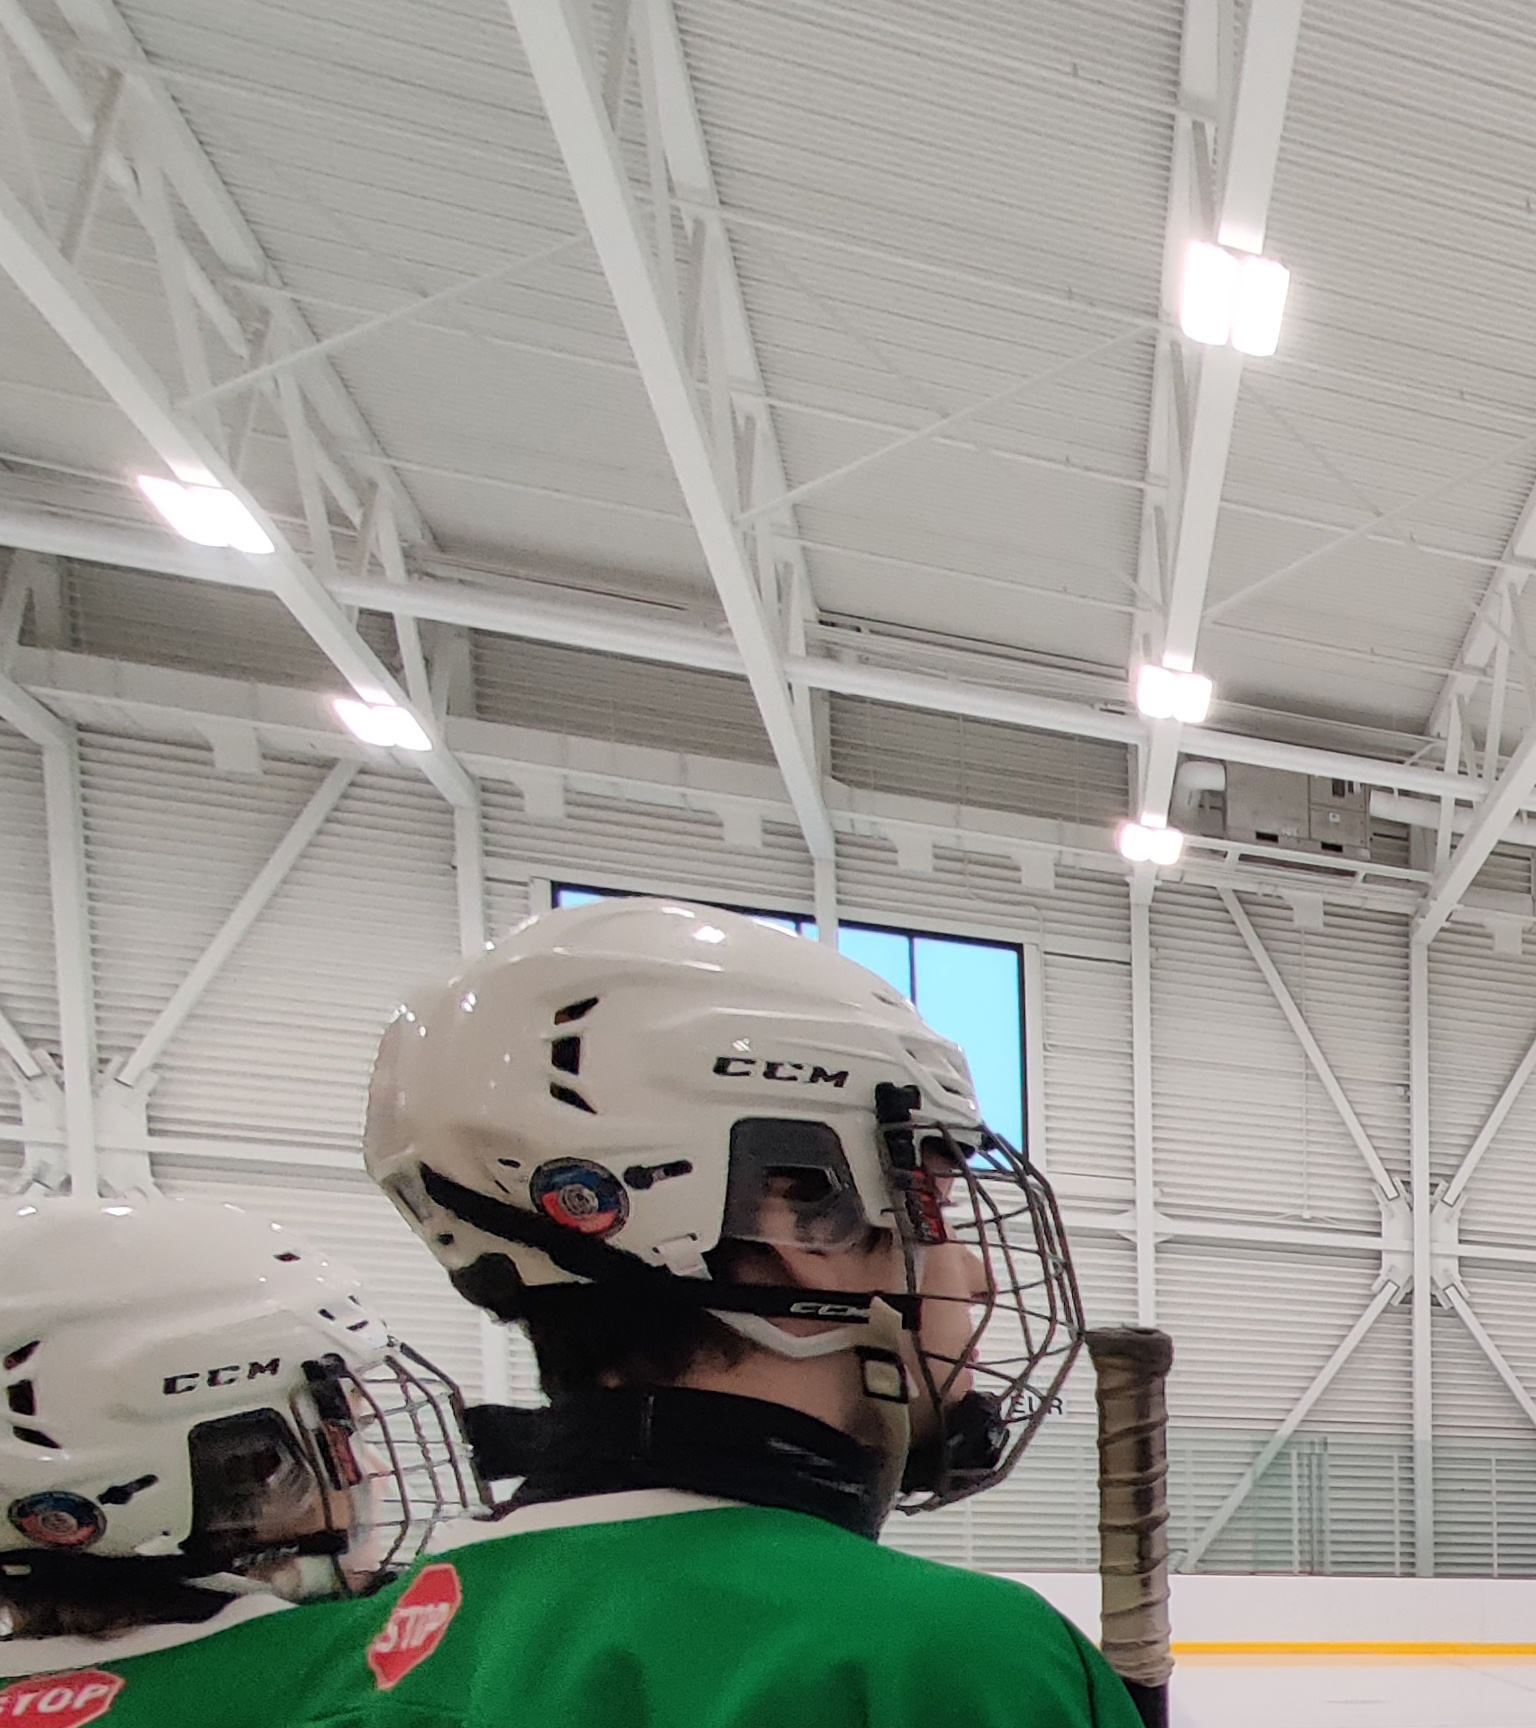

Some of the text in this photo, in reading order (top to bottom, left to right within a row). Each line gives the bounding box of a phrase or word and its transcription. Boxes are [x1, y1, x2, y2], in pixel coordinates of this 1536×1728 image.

[712, 1056, 849, 1088] CCM
[162, 1357, 280, 1395] CCM
[0, 1683, 111, 1717] TOP
